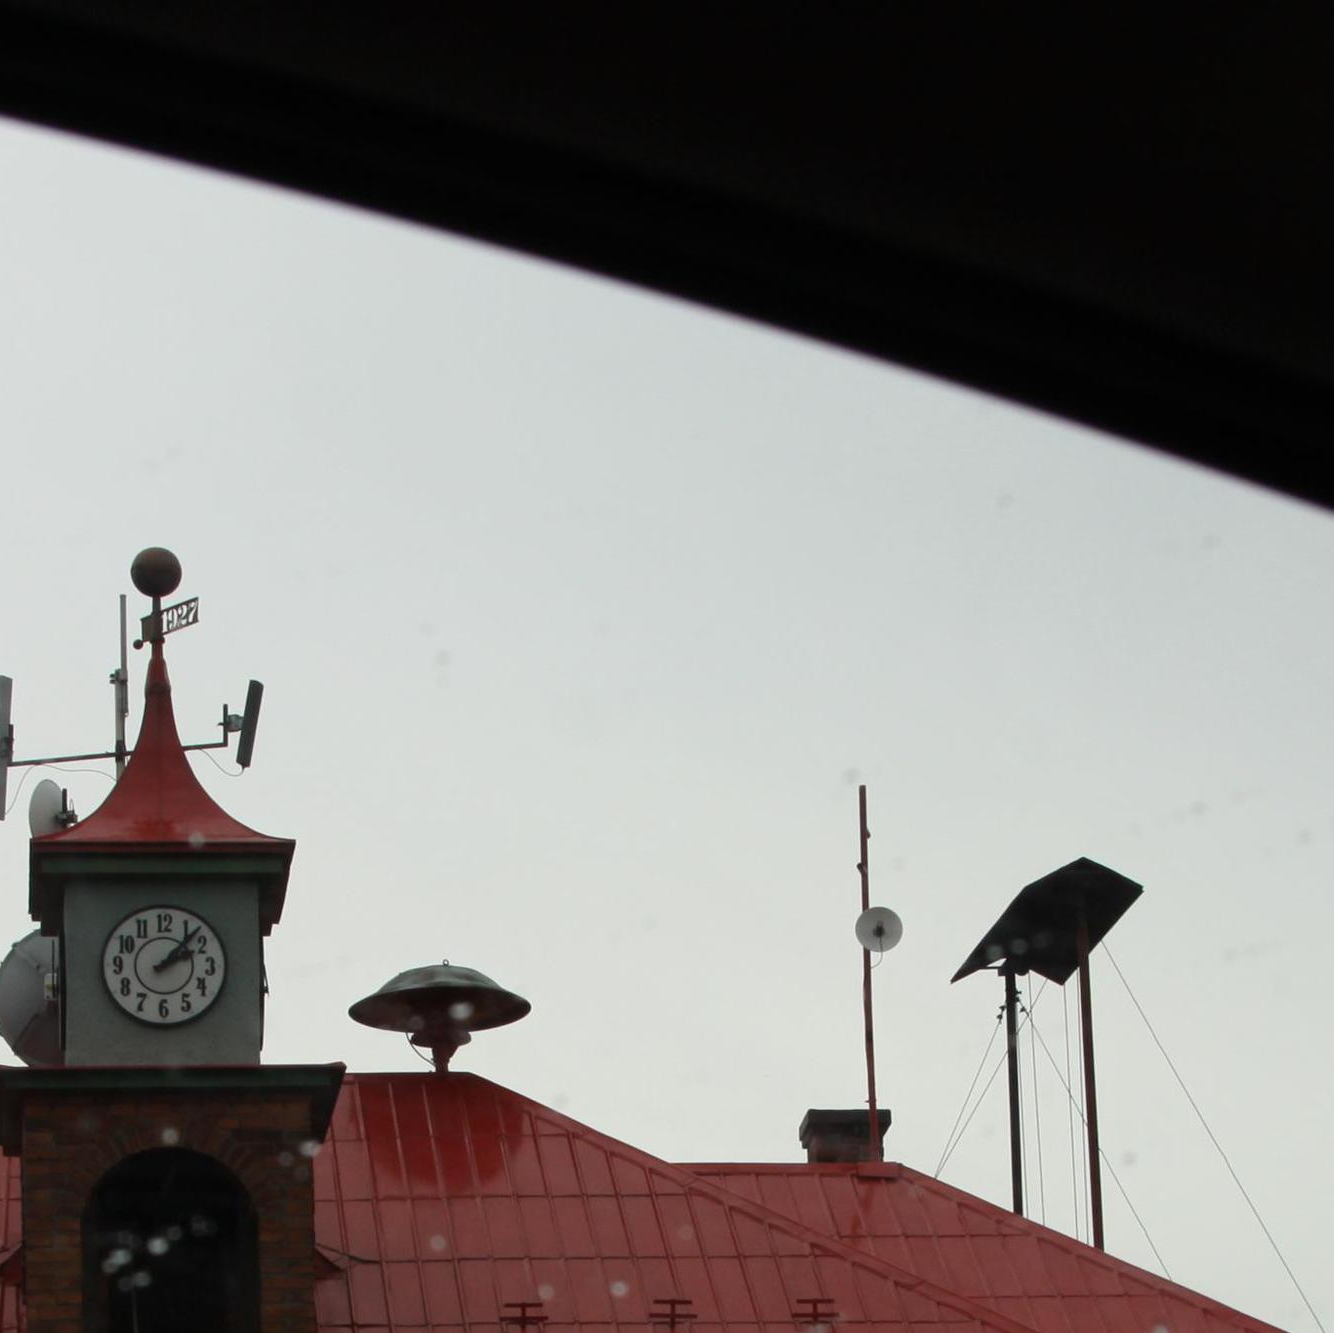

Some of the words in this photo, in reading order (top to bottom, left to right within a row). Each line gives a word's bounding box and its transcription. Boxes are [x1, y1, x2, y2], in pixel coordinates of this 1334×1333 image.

[161, 599, 198, 634] 1927
[136, 919, 147, 938] 11
[157, 914, 172, 933] 12
[119, 935, 135, 954] 10
[197, 935, 207, 954] 2
[113, 955, 123, 975] 9
[205, 956, 216, 976] 3
[120, 977, 131, 996] 8
[196, 977, 206, 997] 4
[136, 993, 147, 1012] 7
[158, 999, 169, 1018] 6
[181, 993, 191, 1012] 5
